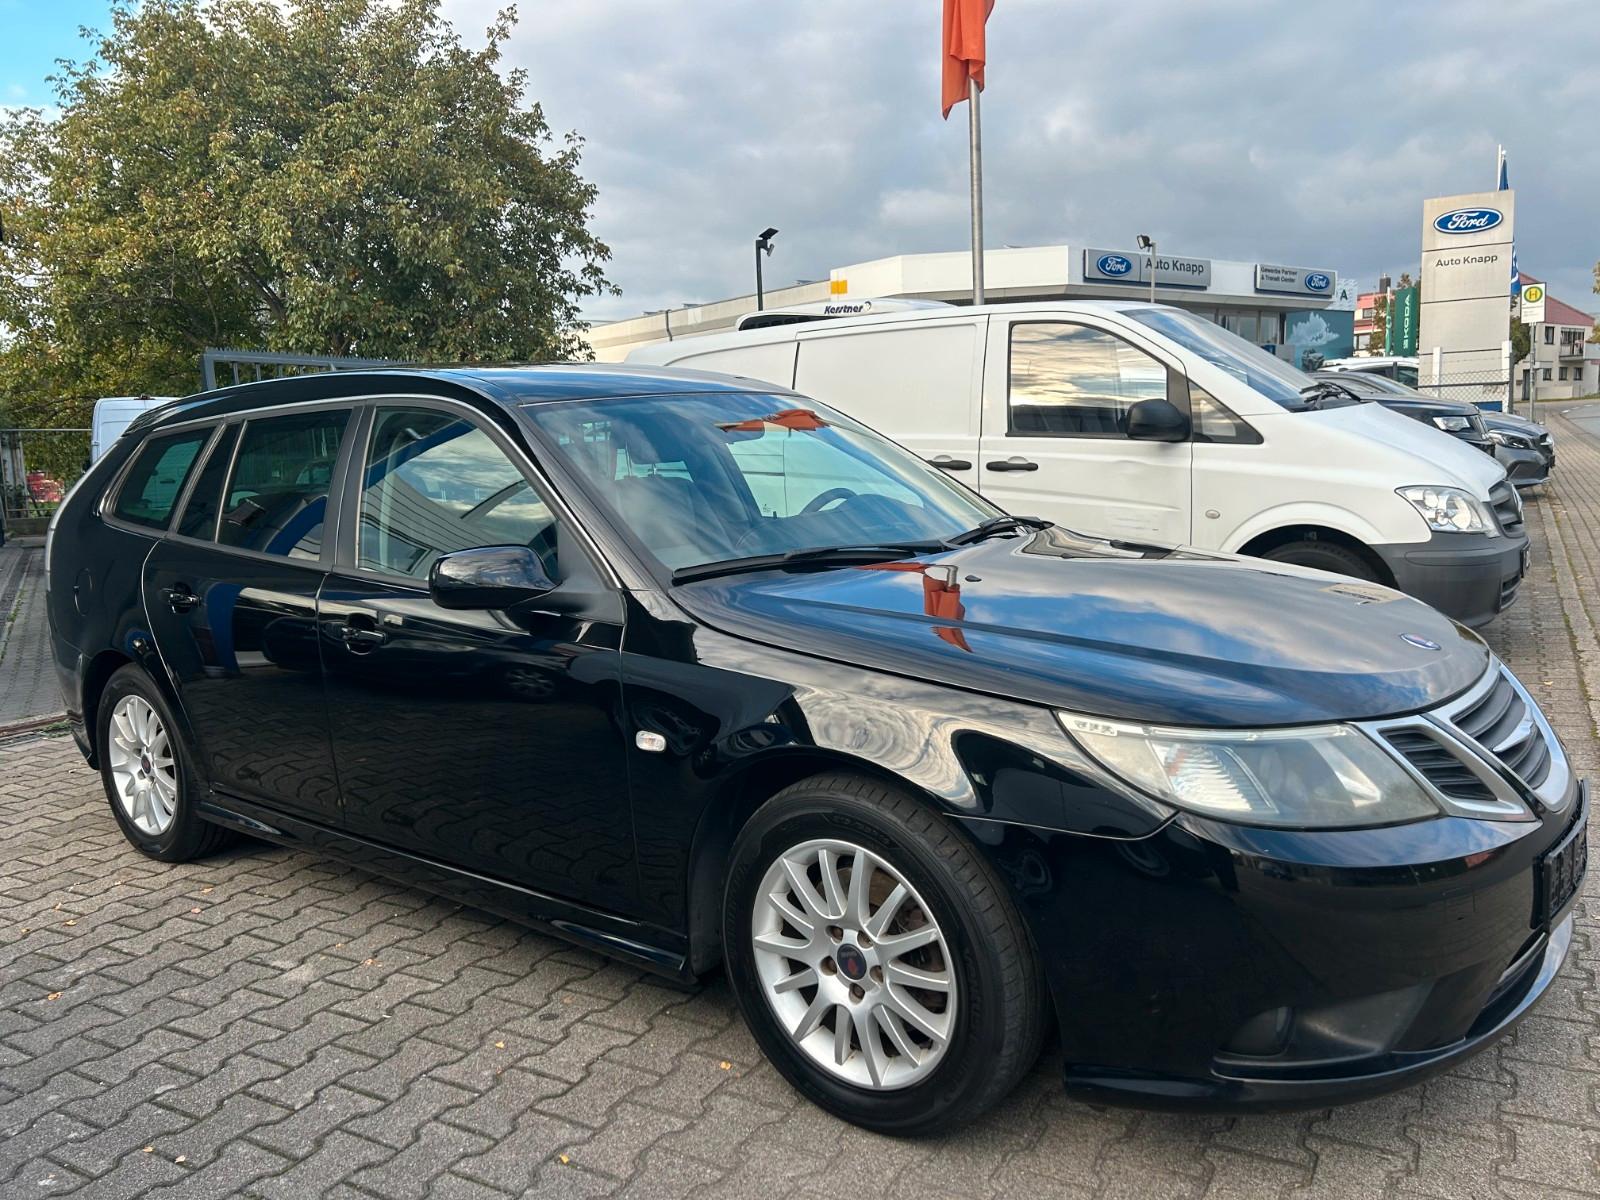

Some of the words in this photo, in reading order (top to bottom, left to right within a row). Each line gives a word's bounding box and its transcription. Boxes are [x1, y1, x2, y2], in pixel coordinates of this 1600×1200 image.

[1145, 257, 1170, 270] Auto
[1172, 260, 1204, 275] Knapp
[1435, 257, 1461, 267] Auto
[1463, 255, 1498, 265] Knapp
[1529, 289, 1538, 300] H
